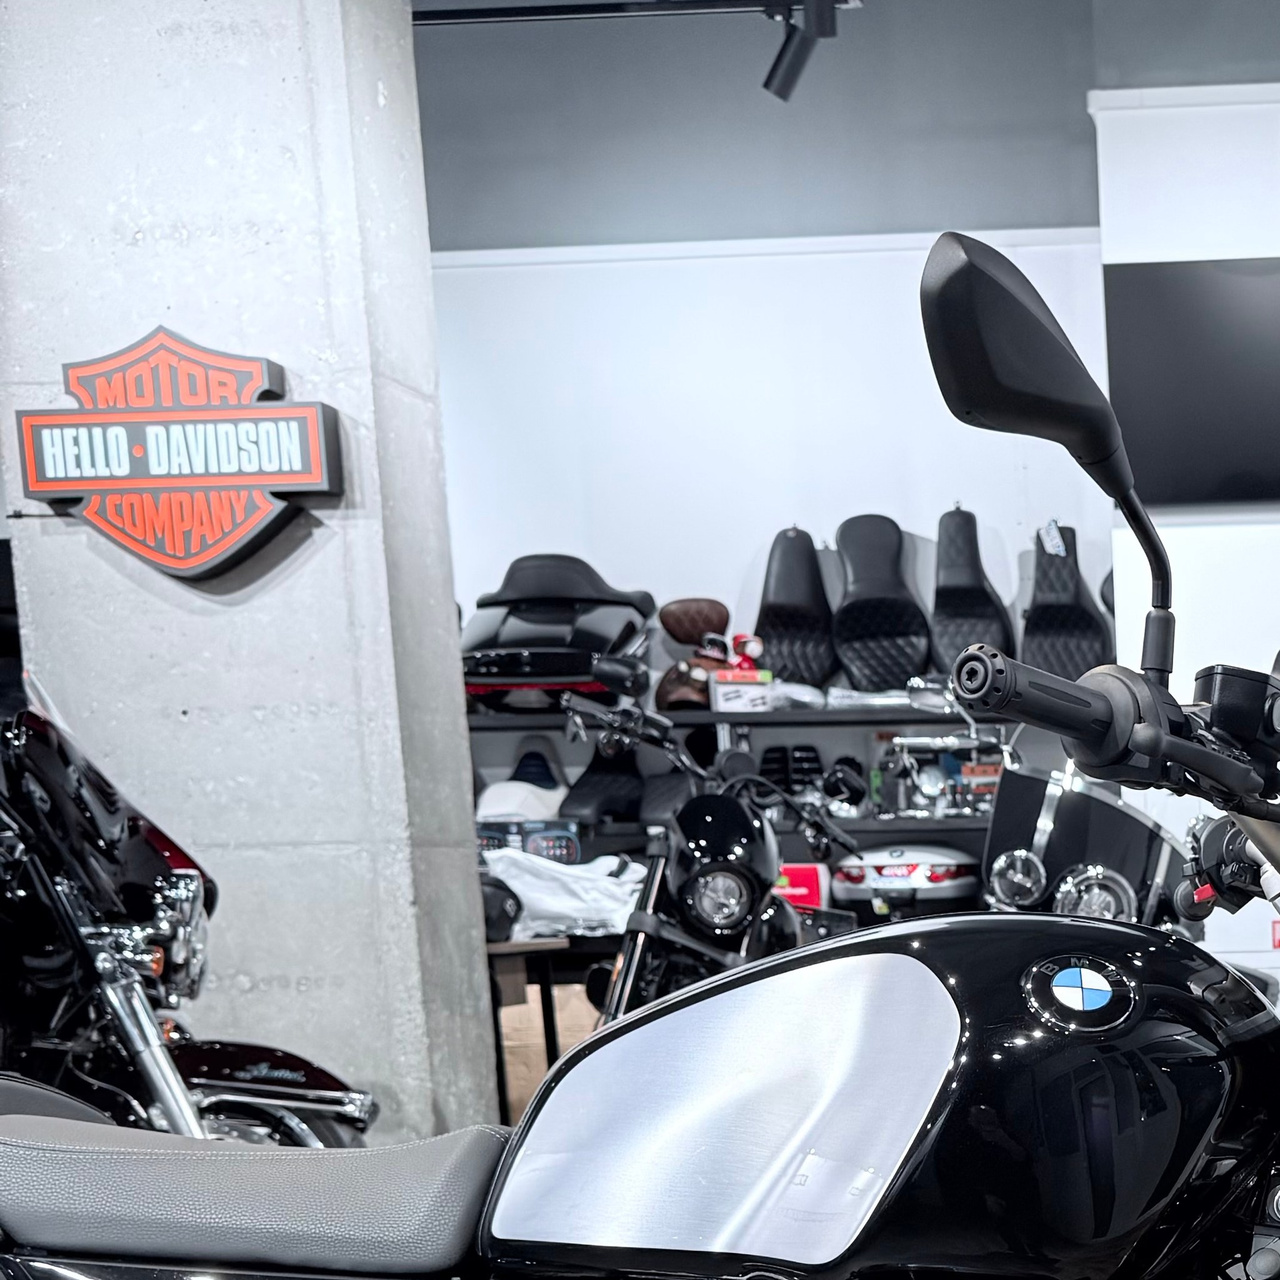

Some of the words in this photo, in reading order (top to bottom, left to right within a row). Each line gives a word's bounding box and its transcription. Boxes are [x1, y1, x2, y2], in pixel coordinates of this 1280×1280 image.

[95, 349, 239, 408] MOTOR
[41, 425, 131, 478] HELLO
[145, 420, 301, 475] DAVIDSON
[105, 489, 249, 557] COMPANY
[1040, 957, 1121, 982] BMW
